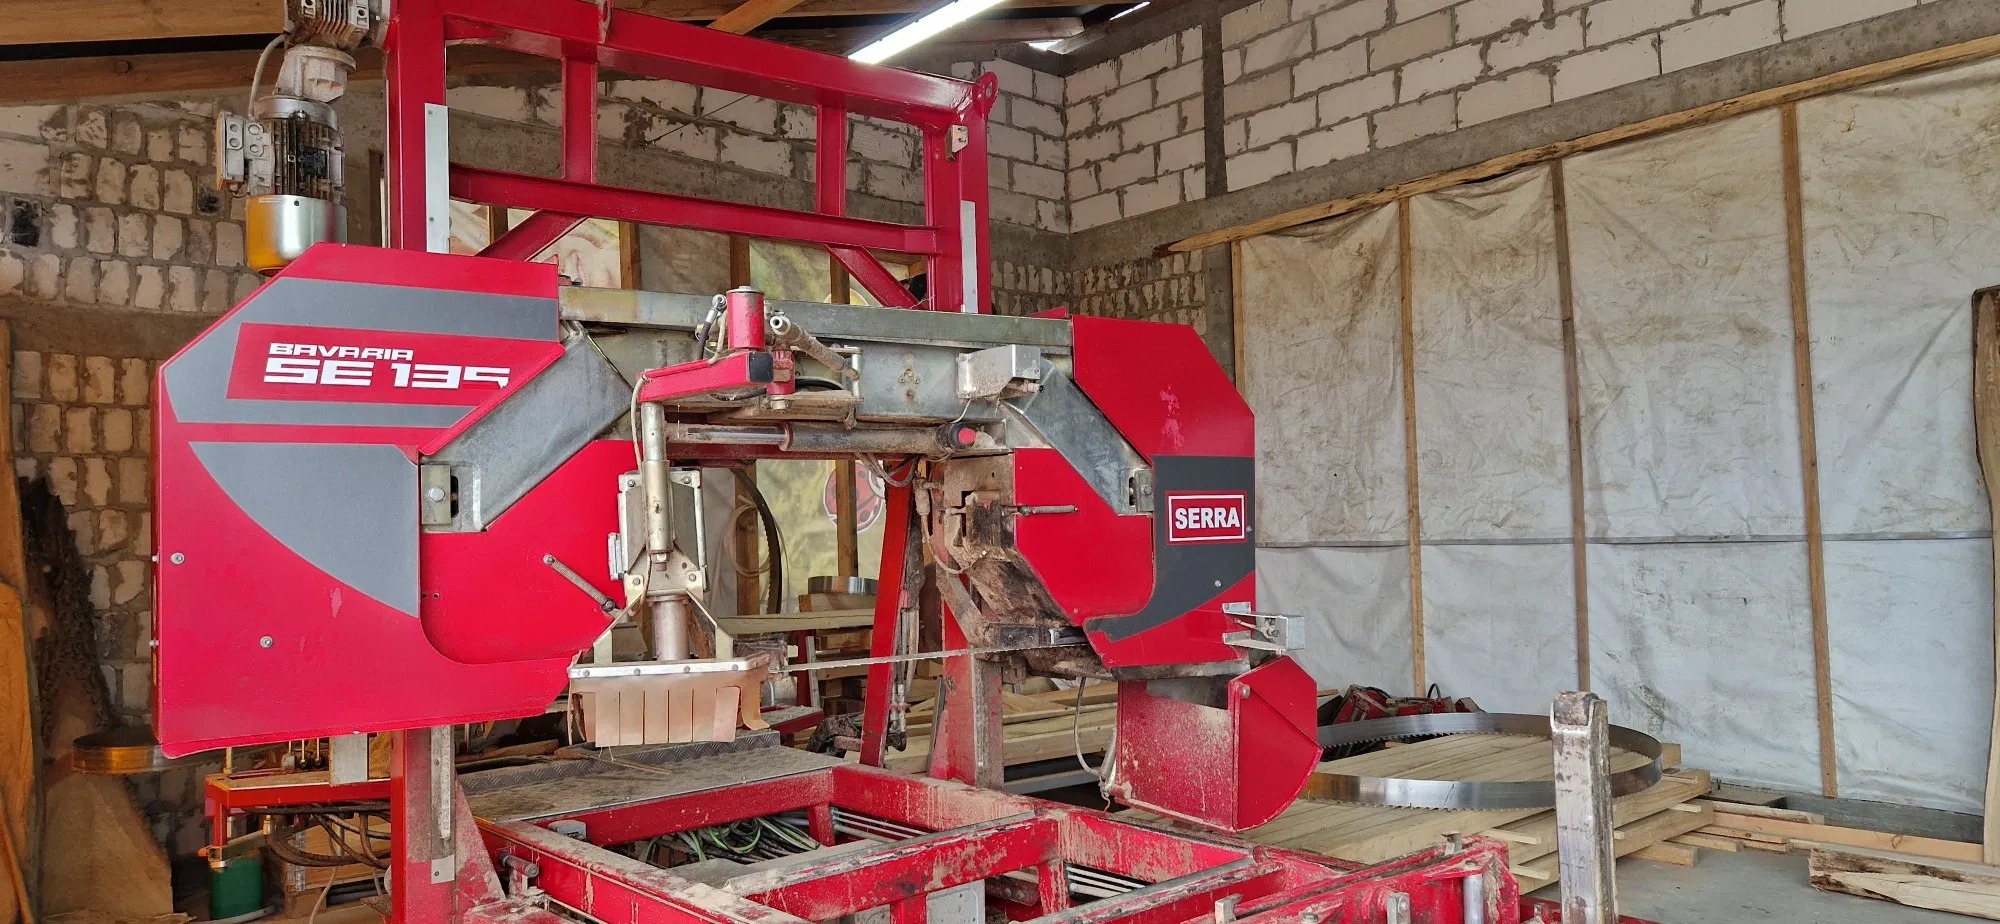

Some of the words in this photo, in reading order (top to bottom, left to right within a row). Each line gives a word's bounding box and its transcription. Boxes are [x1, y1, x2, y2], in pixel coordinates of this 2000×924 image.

[269, 343, 414, 361] BAVARIA
[264, 357, 375, 386] SE
[391, 363, 511, 390] 135
[1175, 507, 1241, 529] SERRA
